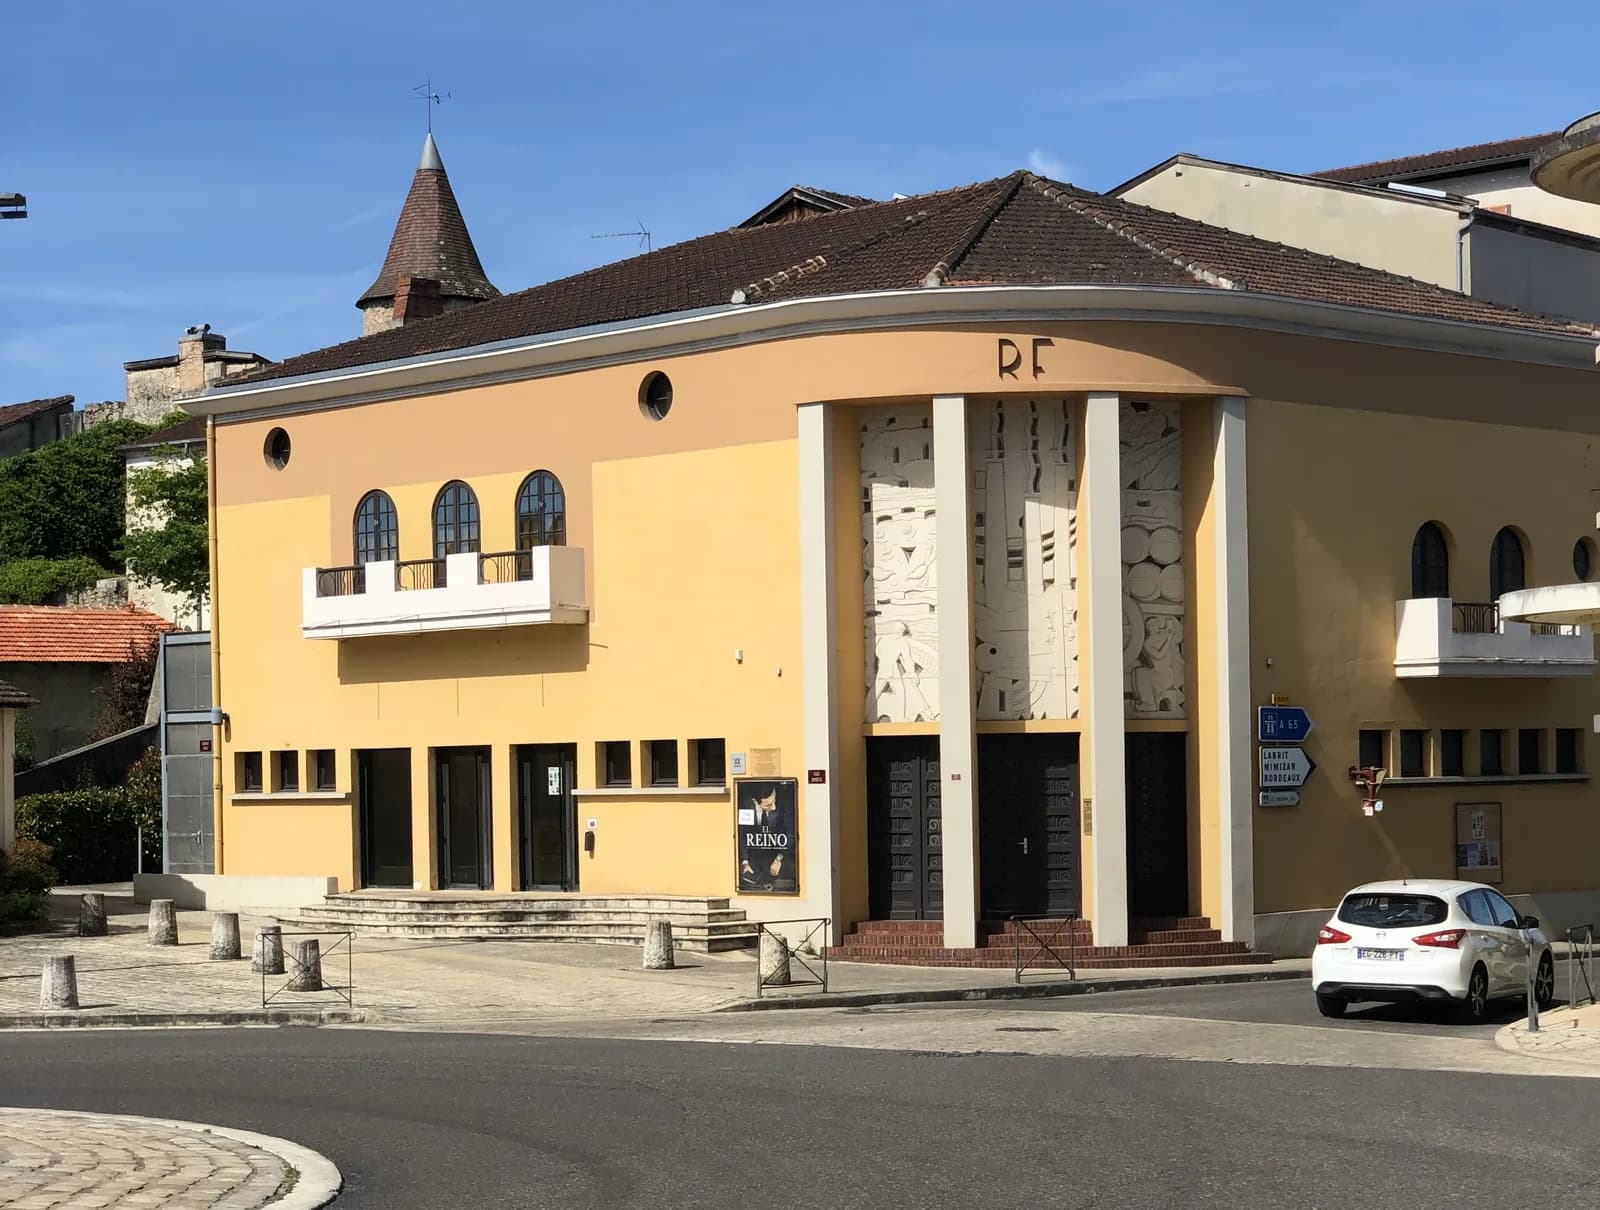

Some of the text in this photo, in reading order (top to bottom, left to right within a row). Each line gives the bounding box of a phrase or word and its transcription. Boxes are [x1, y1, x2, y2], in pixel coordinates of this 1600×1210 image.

[998, 338, 1056, 381] RF
[1279, 719, 1299, 730] A 65
[1263, 751, 1289, 760] LABRIT
[1263, 762, 1296, 771] MIMIZAN
[1263, 774, 1301, 783] BORDEAUX
[746, 833, 788, 847] REINO
